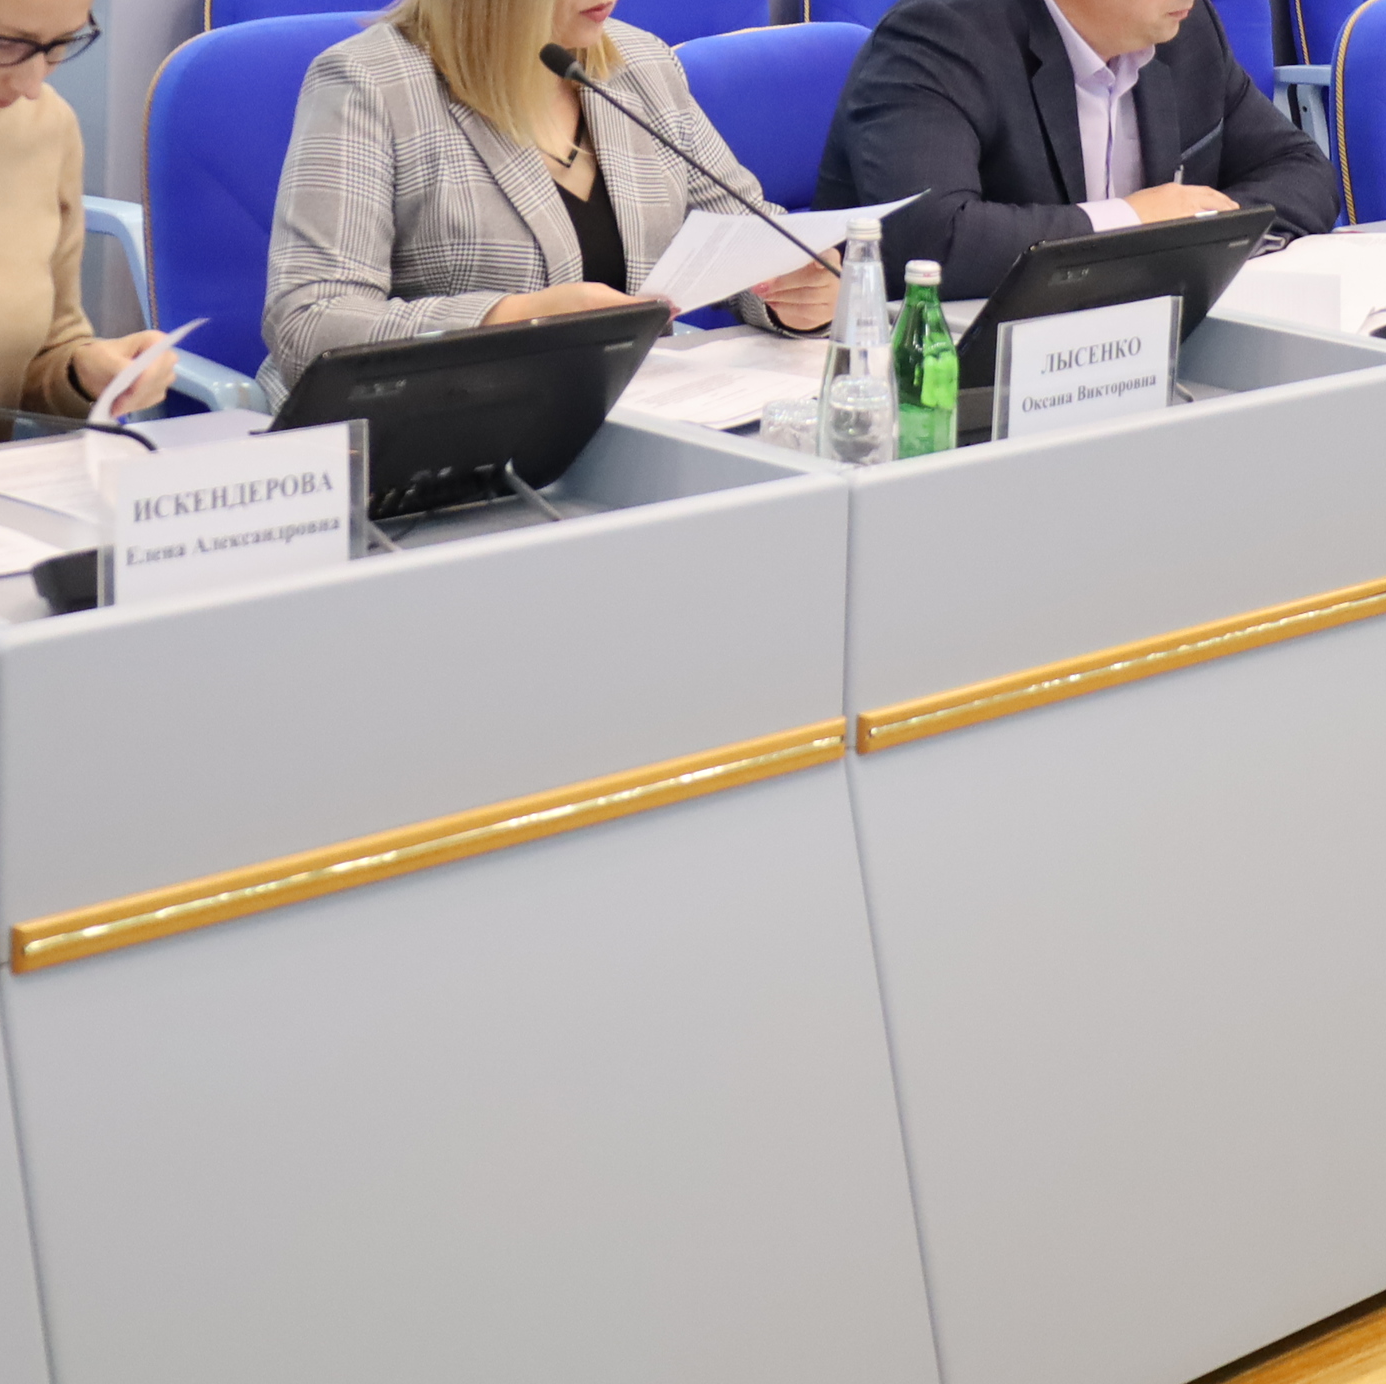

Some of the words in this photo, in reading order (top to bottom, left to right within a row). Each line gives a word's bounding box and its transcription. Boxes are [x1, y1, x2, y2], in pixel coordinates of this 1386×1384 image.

[1040, 336, 1142, 375] ЛЫСЕНКО
[1022, 391, 1072, 413] Оксана
[1077, 374, 1156, 402] Викторовна
[133, 470, 334, 523] ИСКЕНДЕРОВА
[126, 540, 186, 566] Елена
[192, 516, 341, 554] Александровна
